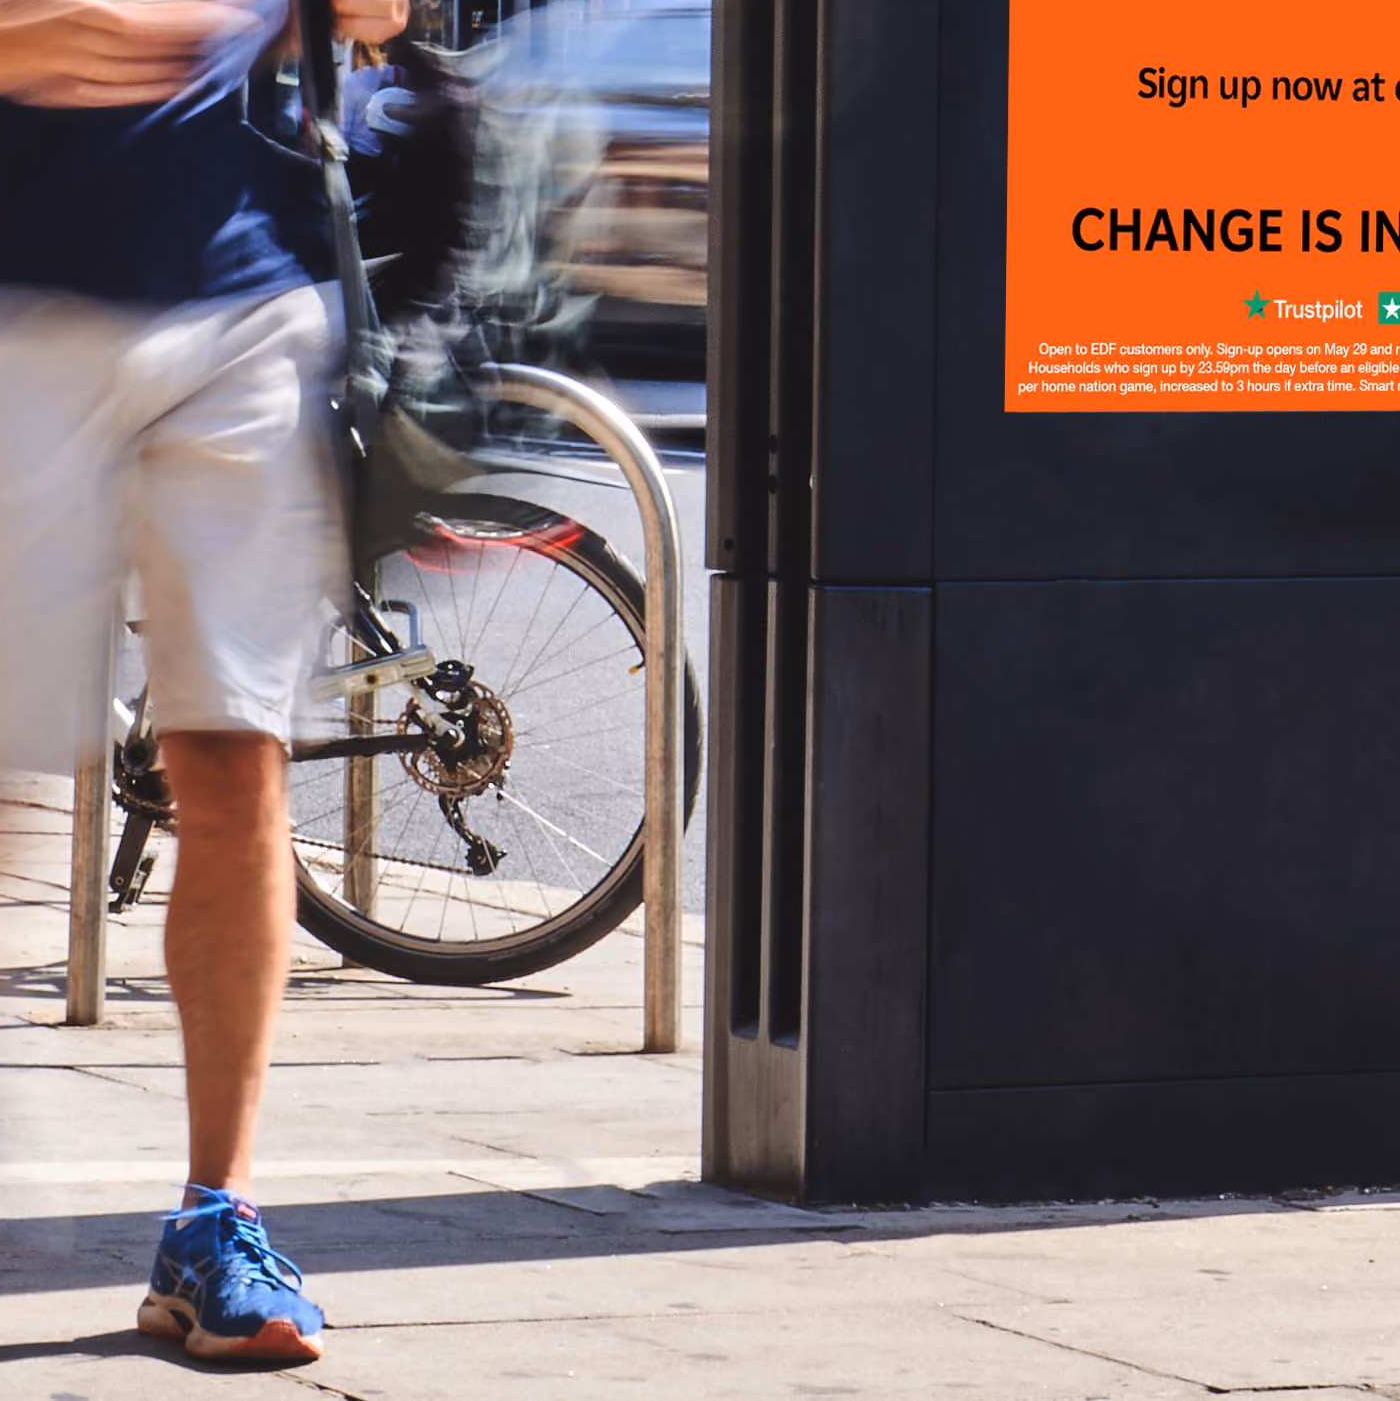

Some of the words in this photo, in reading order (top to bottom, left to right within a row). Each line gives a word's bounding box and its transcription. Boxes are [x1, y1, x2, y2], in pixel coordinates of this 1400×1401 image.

[1139, 67, 1208, 108] Sign
[1220, 77, 1262, 108] up
[1273, 78, 1342, 101] now
[1352, 73, 1386, 102] at
[1072, 207, 1283, 253] CHANGE
[1301, 209, 1342, 253] IS
[1274, 300, 1364, 323] Trustpilot
[1039, 343, 1073, 357] Open
[1076, 344, 1088, 355] to
[1091, 343, 1117, 355] EDF
[1120, 344, 1183, 355] customers
[1186, 343, 1213, 358] only.
[1217, 343, 1264, 358] Sign-up
[1267, 346, 1303, 357] opens
[1306, 346, 1321, 355] on
[1325, 343, 1350, 358] May
[1353, 343, 1368, 355] 29
[1370, 343, 1393, 355] and
[1029, 361, 1101, 373] Households
[1104, 362, 1130, 373] who
[1133, 362, 1158, 376] sign
[1161, 364, 1177, 376] up
[1180, 362, 1195, 376] by
[1198, 361, 1250, 376] 23.59pm
[1253, 361, 1272, 373] the
[1275, 362, 1297, 376] day
[1300, 361, 1338, 373] before
[1341, 364, 1355, 373] an
[1358, 361, 1400, 376] eligible
[1018, 383, 1039, 395] per
[1042, 380, 1076, 392] home
[1079, 381, 1117, 392] nation
[1120, 383, 1157, 395] game,
[1160, 380, 1218, 391] increased
[1221, 381, 1234, 391] to
[1237, 380, 1245, 391] 3
[1247, 379, 1282, 391] hours
[1284, 380, 1292, 391] if
[1295, 381, 1325, 391] extra
[1327, 380, 1356, 391] time.
[1360, 380, 1395, 391] Smart
